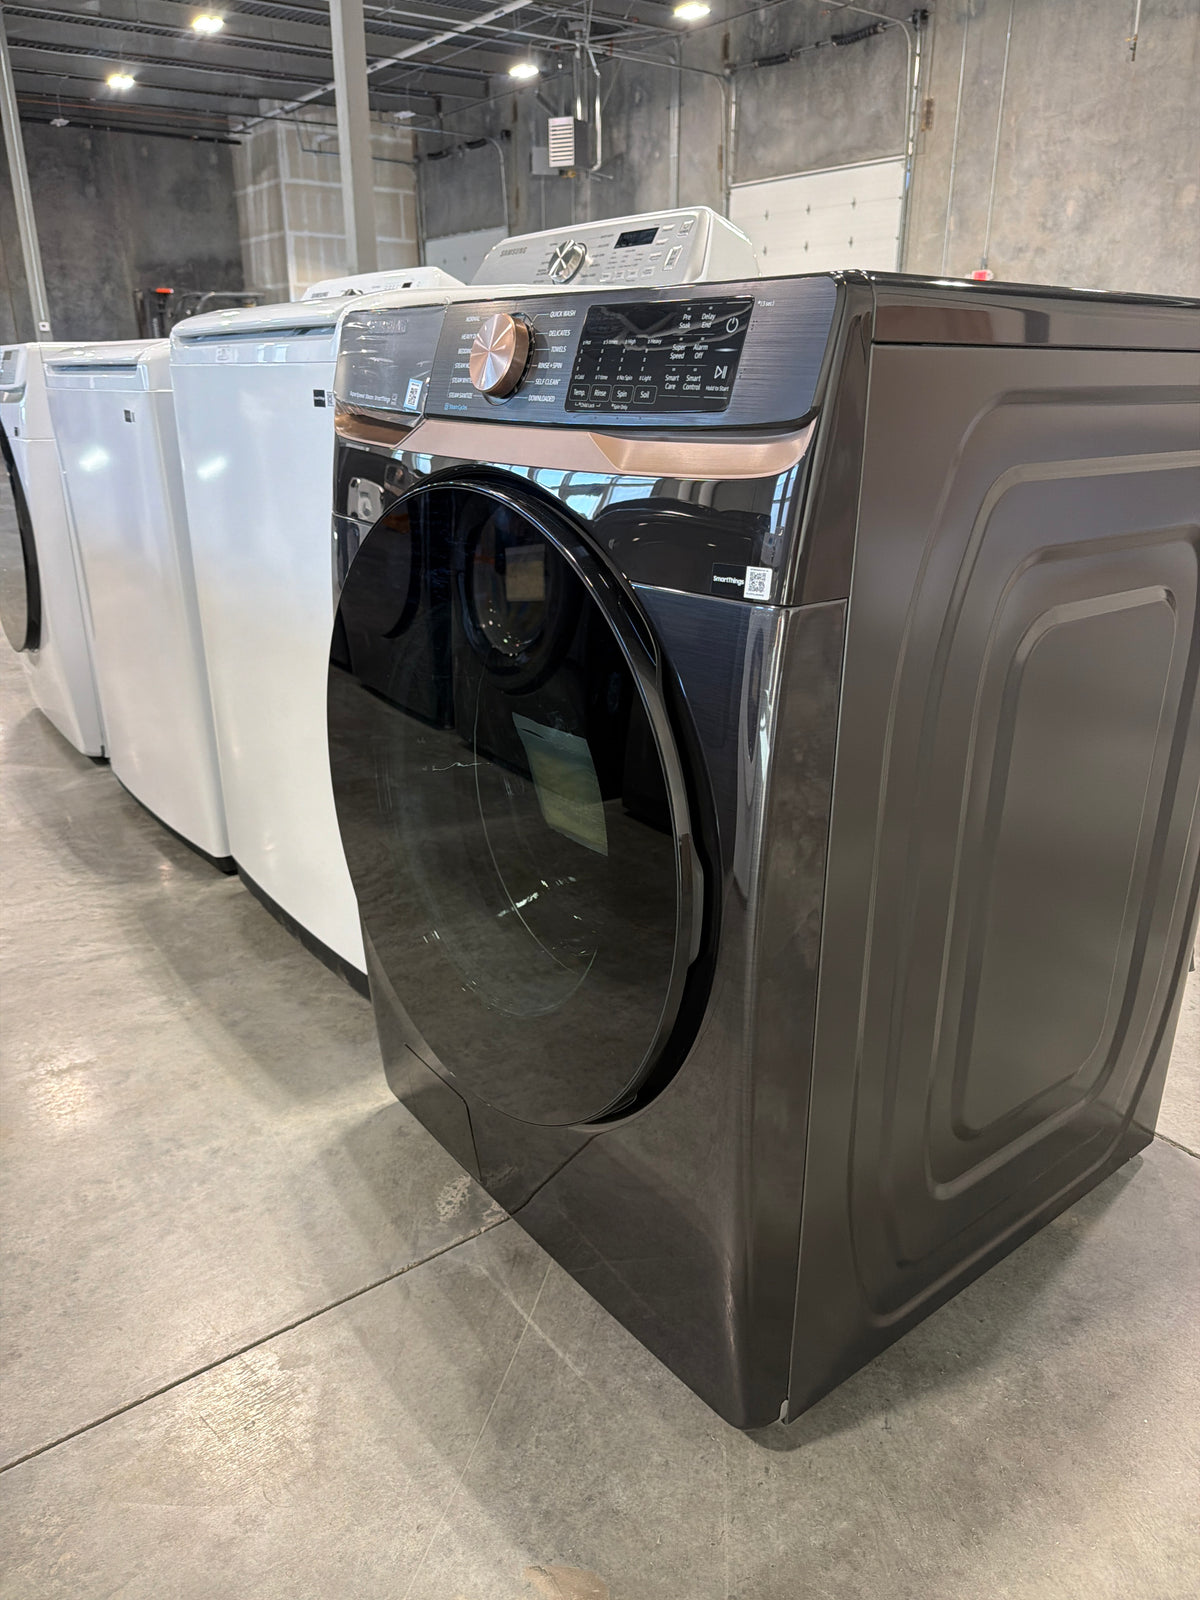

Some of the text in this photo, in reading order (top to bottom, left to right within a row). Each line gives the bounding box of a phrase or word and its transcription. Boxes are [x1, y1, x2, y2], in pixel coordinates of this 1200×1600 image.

[548, 329, 571, 337] DELICATES
[669, 352, 685, 360] Speed
[665, 374, 680, 382] Smart
[594, 389, 607, 397] Rinse
[617, 390, 628, 398] Spin
[640, 391, 650, 399] Soil
[712, 575, 745, 587] SmartThings
